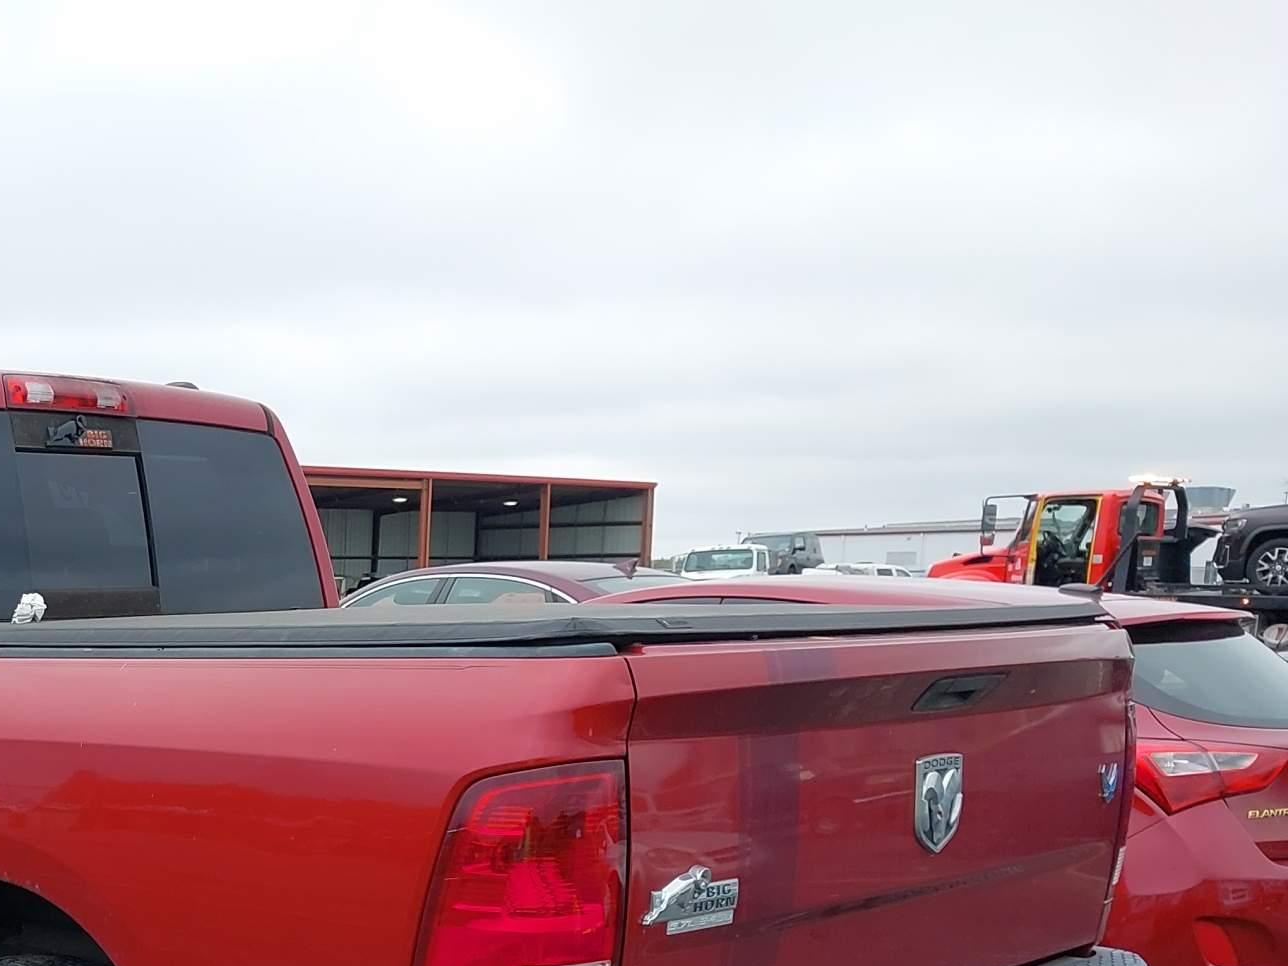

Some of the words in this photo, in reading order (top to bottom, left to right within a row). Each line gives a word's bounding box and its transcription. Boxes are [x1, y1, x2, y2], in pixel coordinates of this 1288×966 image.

[87, 430, 108, 439] BIG
[923, 756, 961, 770] DODGE
[705, 883, 732, 898] BIG
[692, 895, 737, 913] HORN
